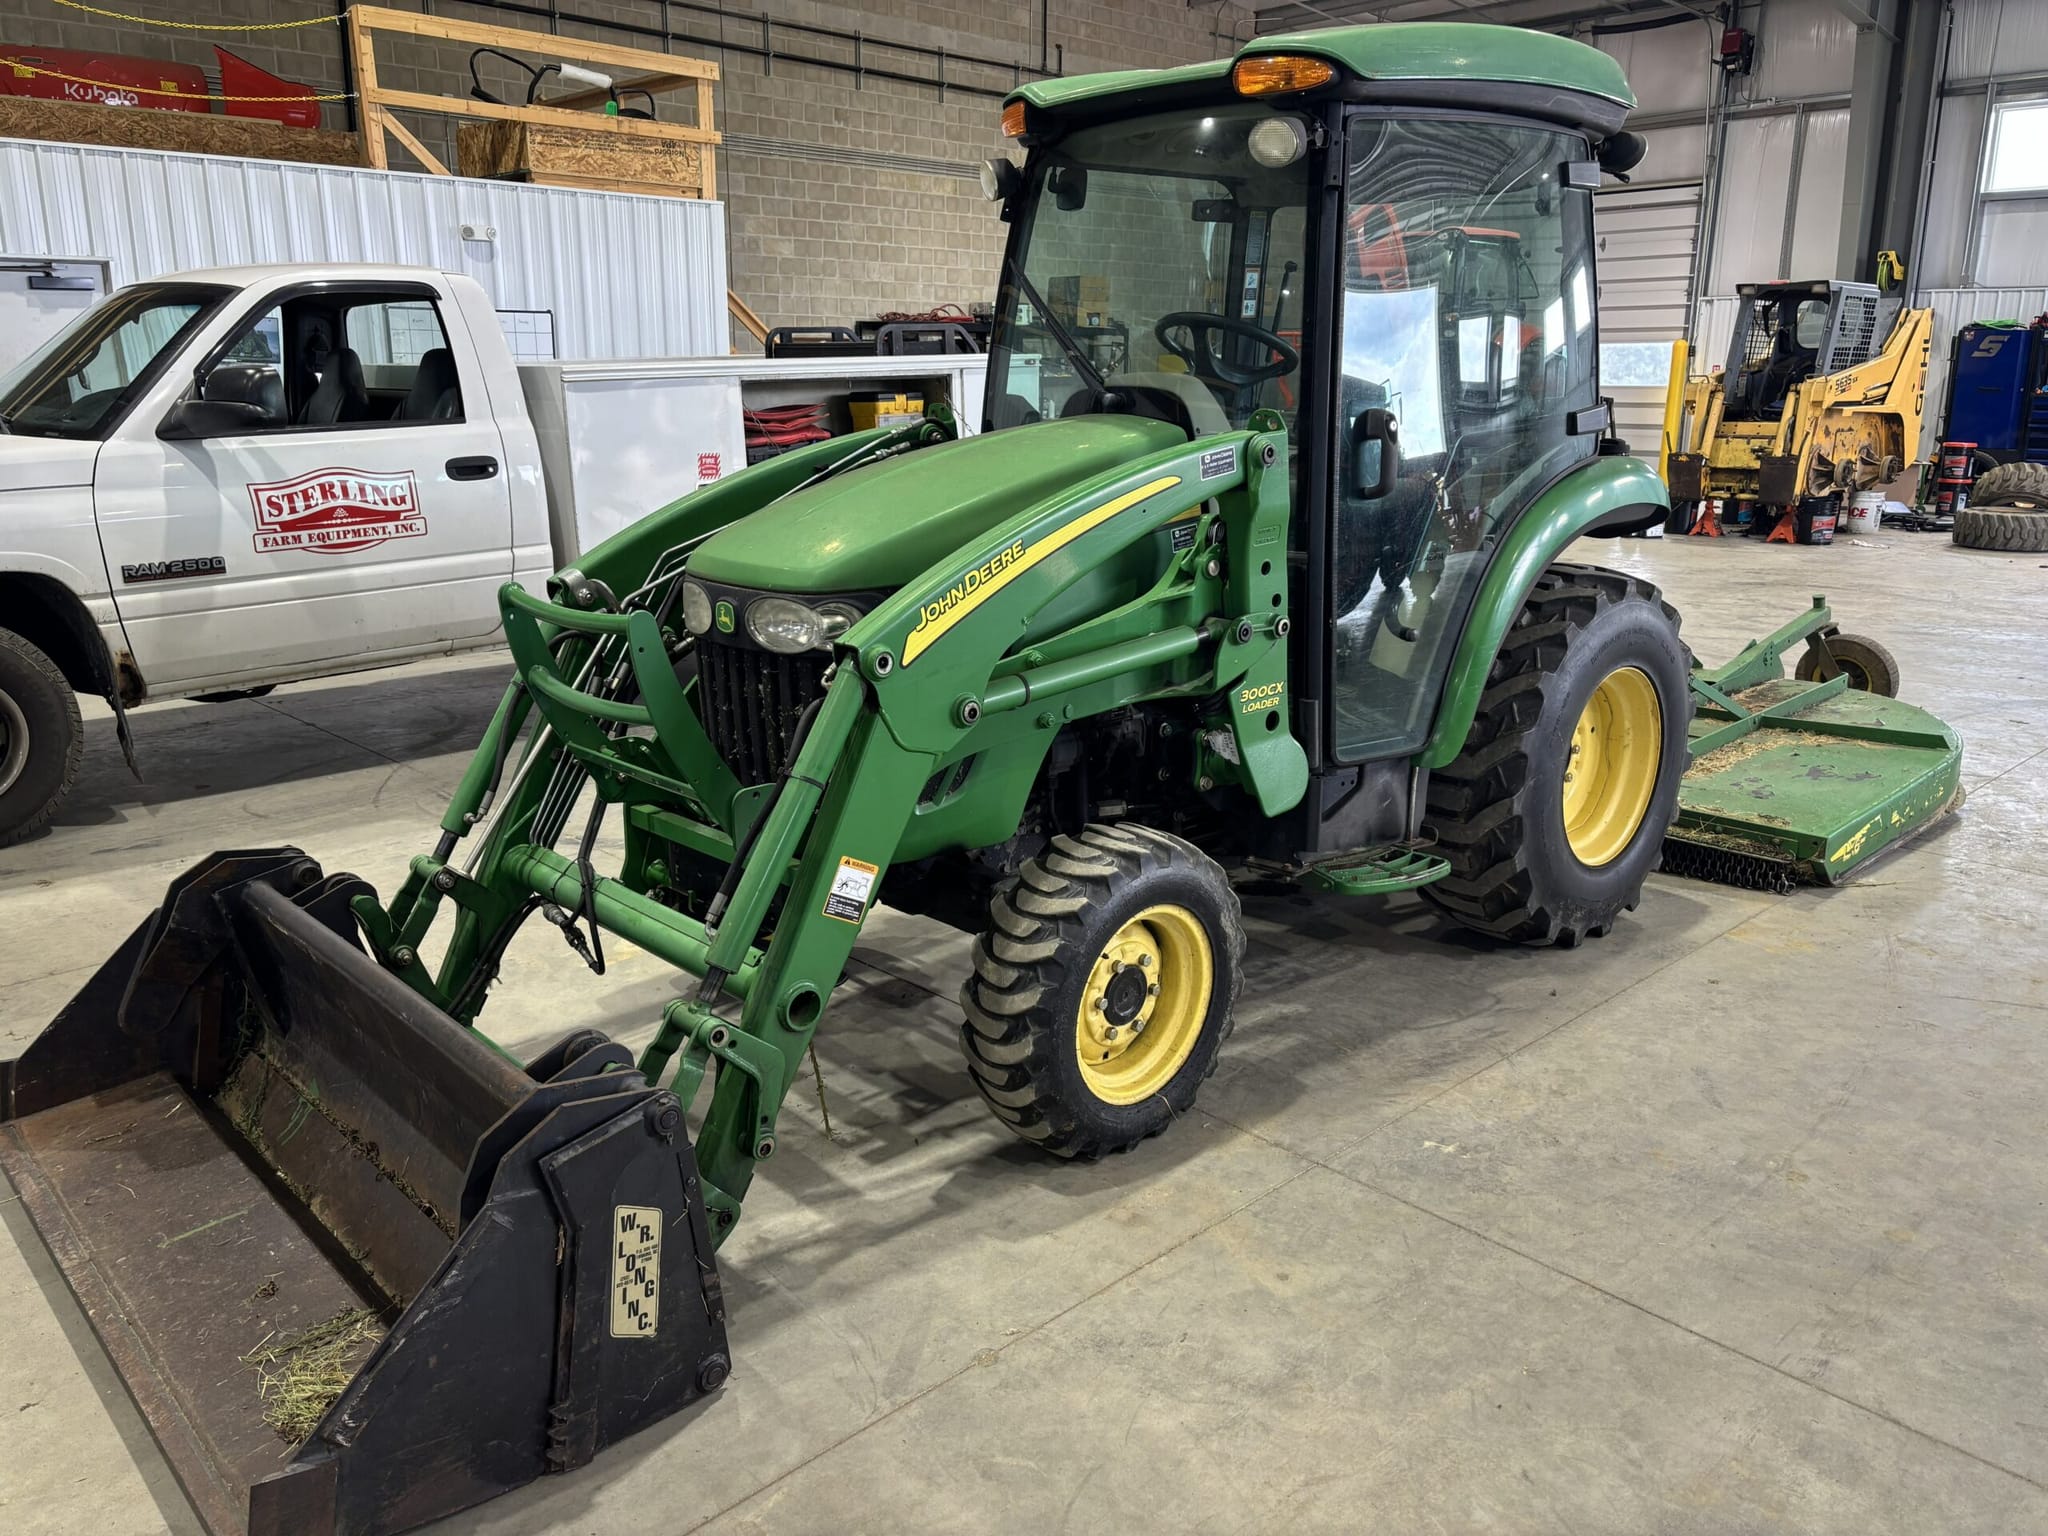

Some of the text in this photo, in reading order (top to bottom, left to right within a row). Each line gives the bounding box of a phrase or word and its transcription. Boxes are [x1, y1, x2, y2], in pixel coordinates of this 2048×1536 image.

[266, 479, 408, 518] STERLING
[262, 522, 421, 548] FARM EQUIPMENT, INC.
[124, 557, 225, 577] RAM 2500
[916, 539, 1026, 632] JOHN DEERE
[1240, 681, 1284, 702] 300CX
[1242, 697, 1280, 713] LOADER
